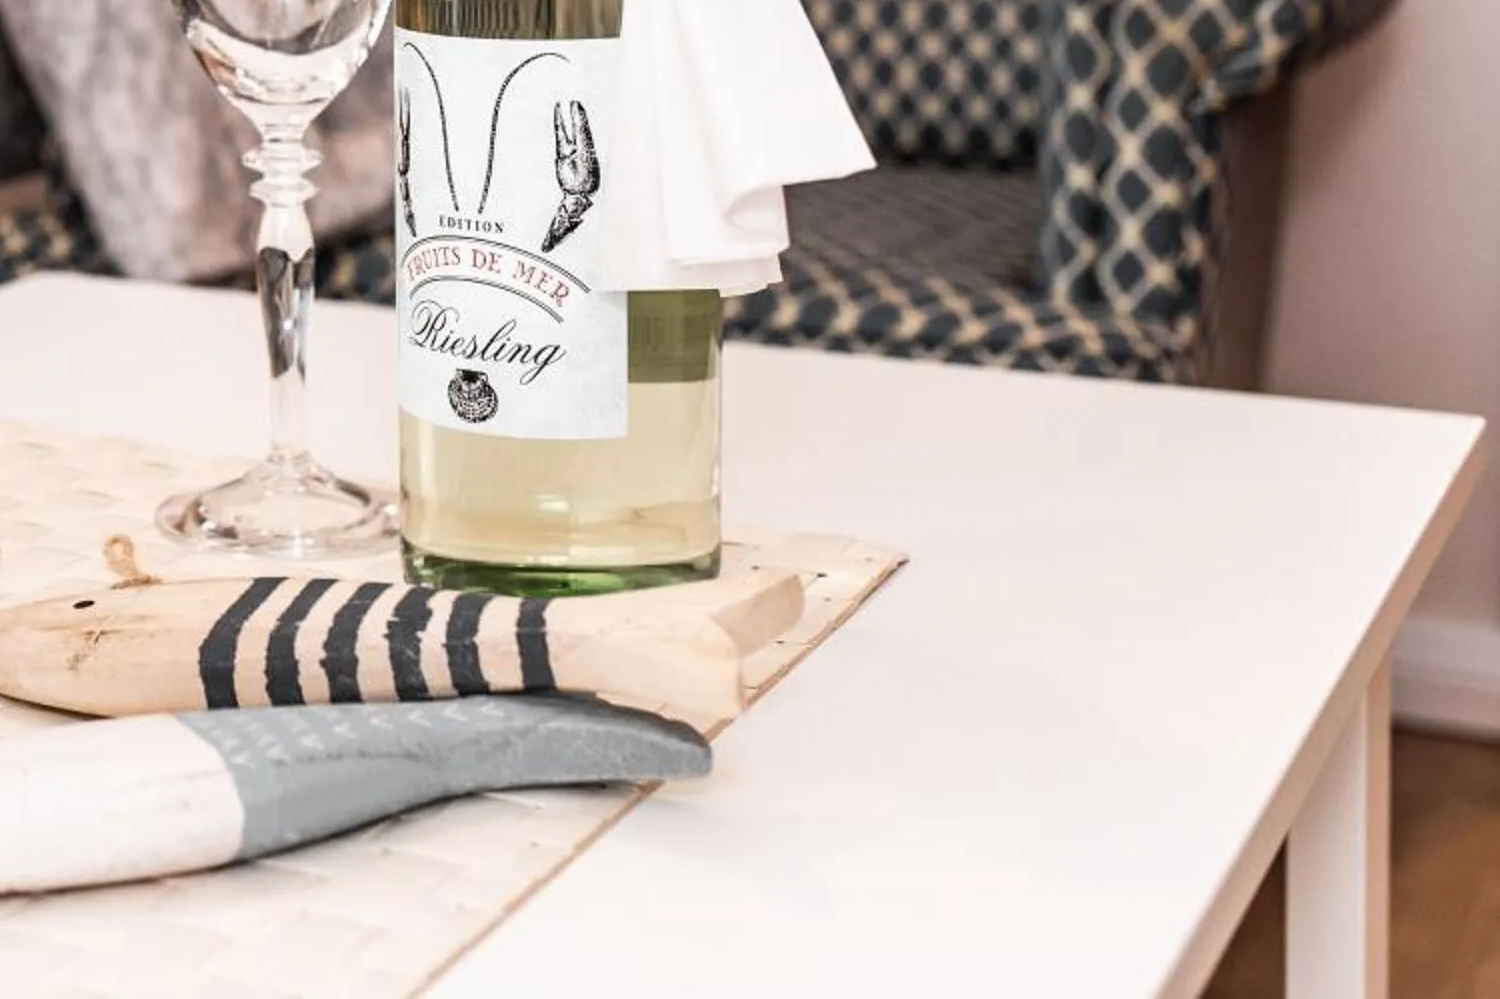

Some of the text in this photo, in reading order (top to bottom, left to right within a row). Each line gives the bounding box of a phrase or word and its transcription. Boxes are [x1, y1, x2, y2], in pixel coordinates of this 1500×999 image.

[438, 214, 504, 234] EDITION
[405, 245, 571, 308] FRUITS DE MER
[408, 299, 567, 386] Riesling
